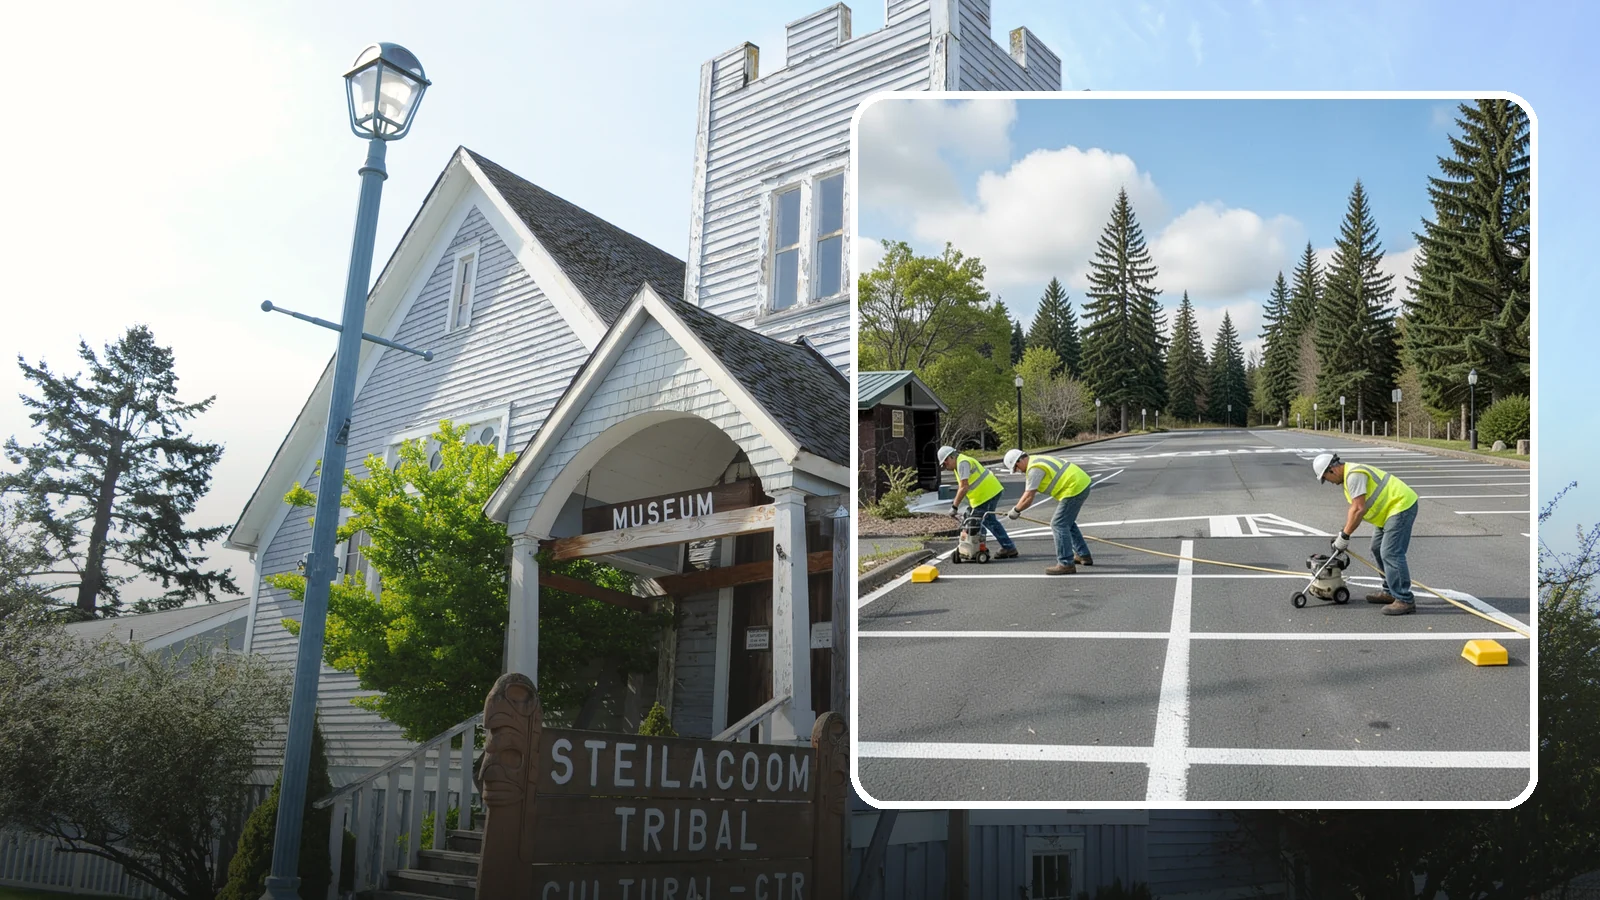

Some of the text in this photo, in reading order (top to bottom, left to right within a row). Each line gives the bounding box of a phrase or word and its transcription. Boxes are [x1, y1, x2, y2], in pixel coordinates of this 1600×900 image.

[613, 491, 713, 531] MUSEUM
[550, 738, 810, 793] STEILACOOM
[615, 807, 758, 852] TRIBAL
